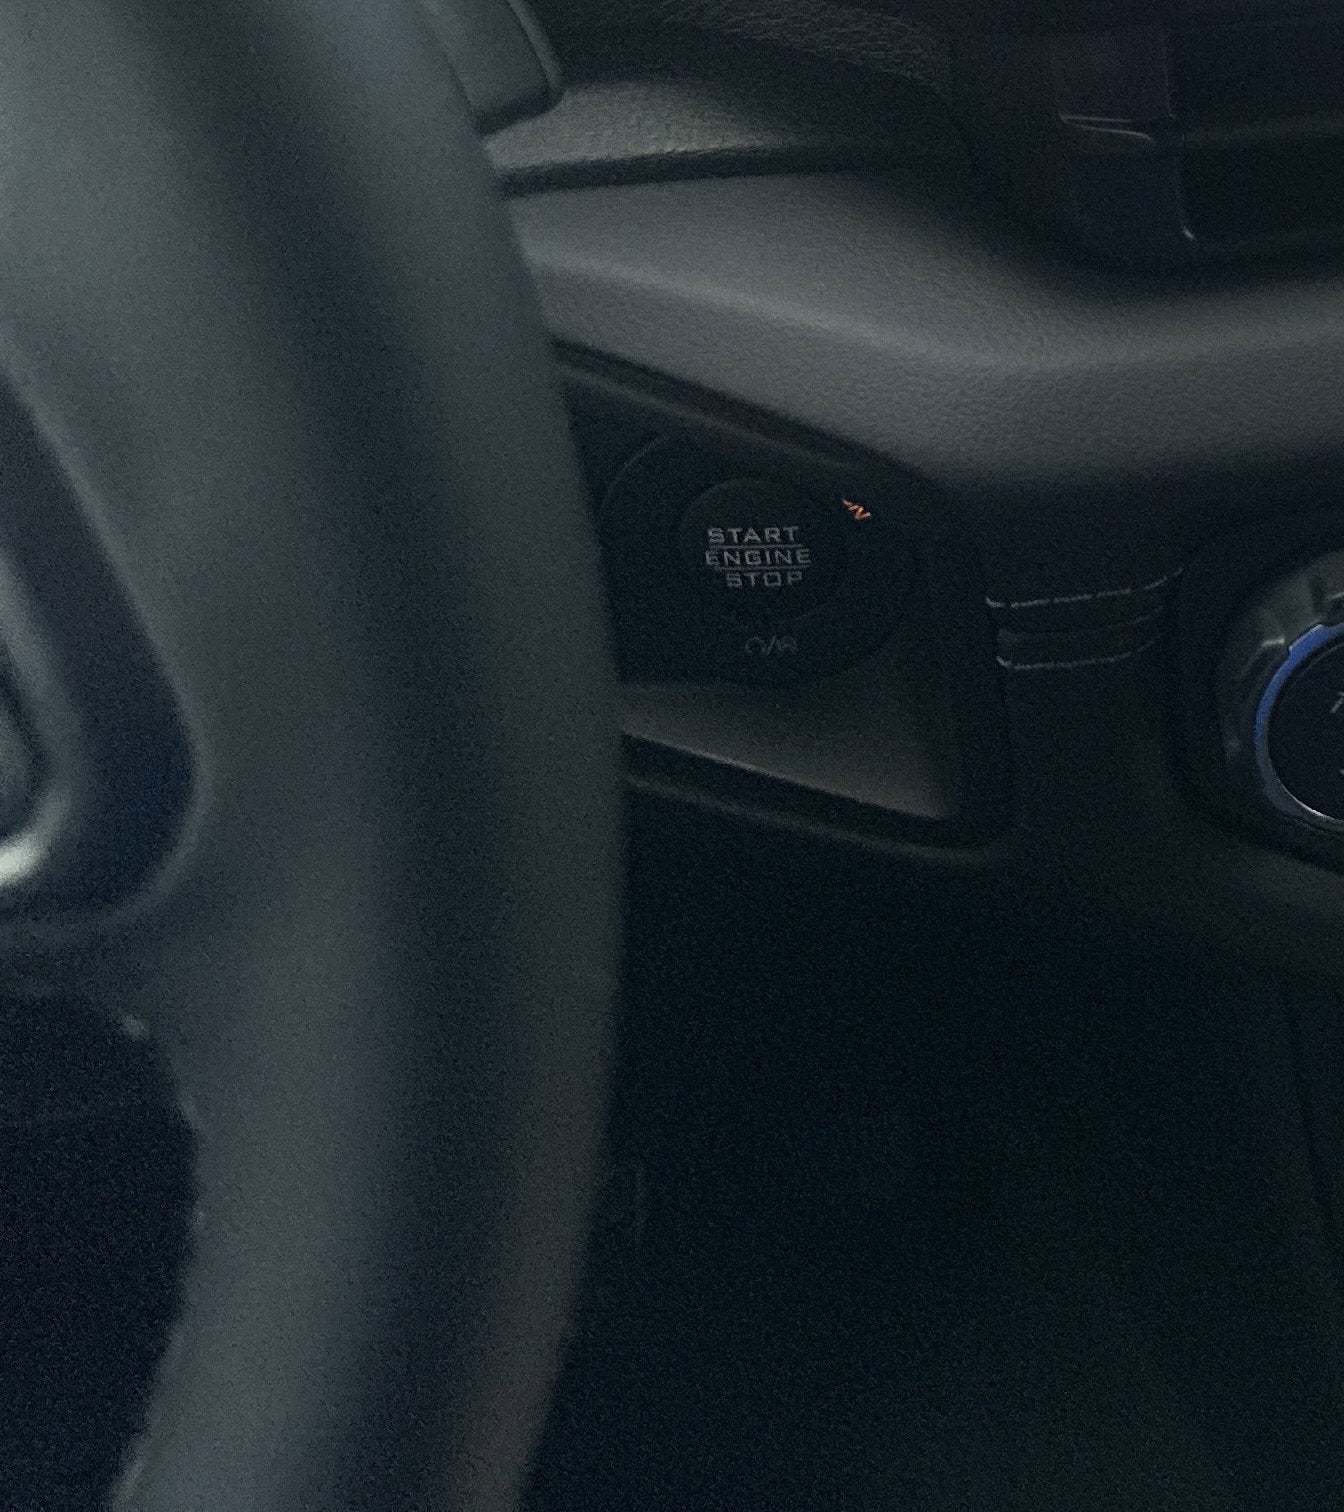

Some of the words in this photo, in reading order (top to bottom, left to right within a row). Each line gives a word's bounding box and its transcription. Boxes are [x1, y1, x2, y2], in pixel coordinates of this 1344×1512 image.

[707, 525, 800, 545] START
[705, 547, 813, 567] ENGINE
[725, 570, 804, 589] STOP
